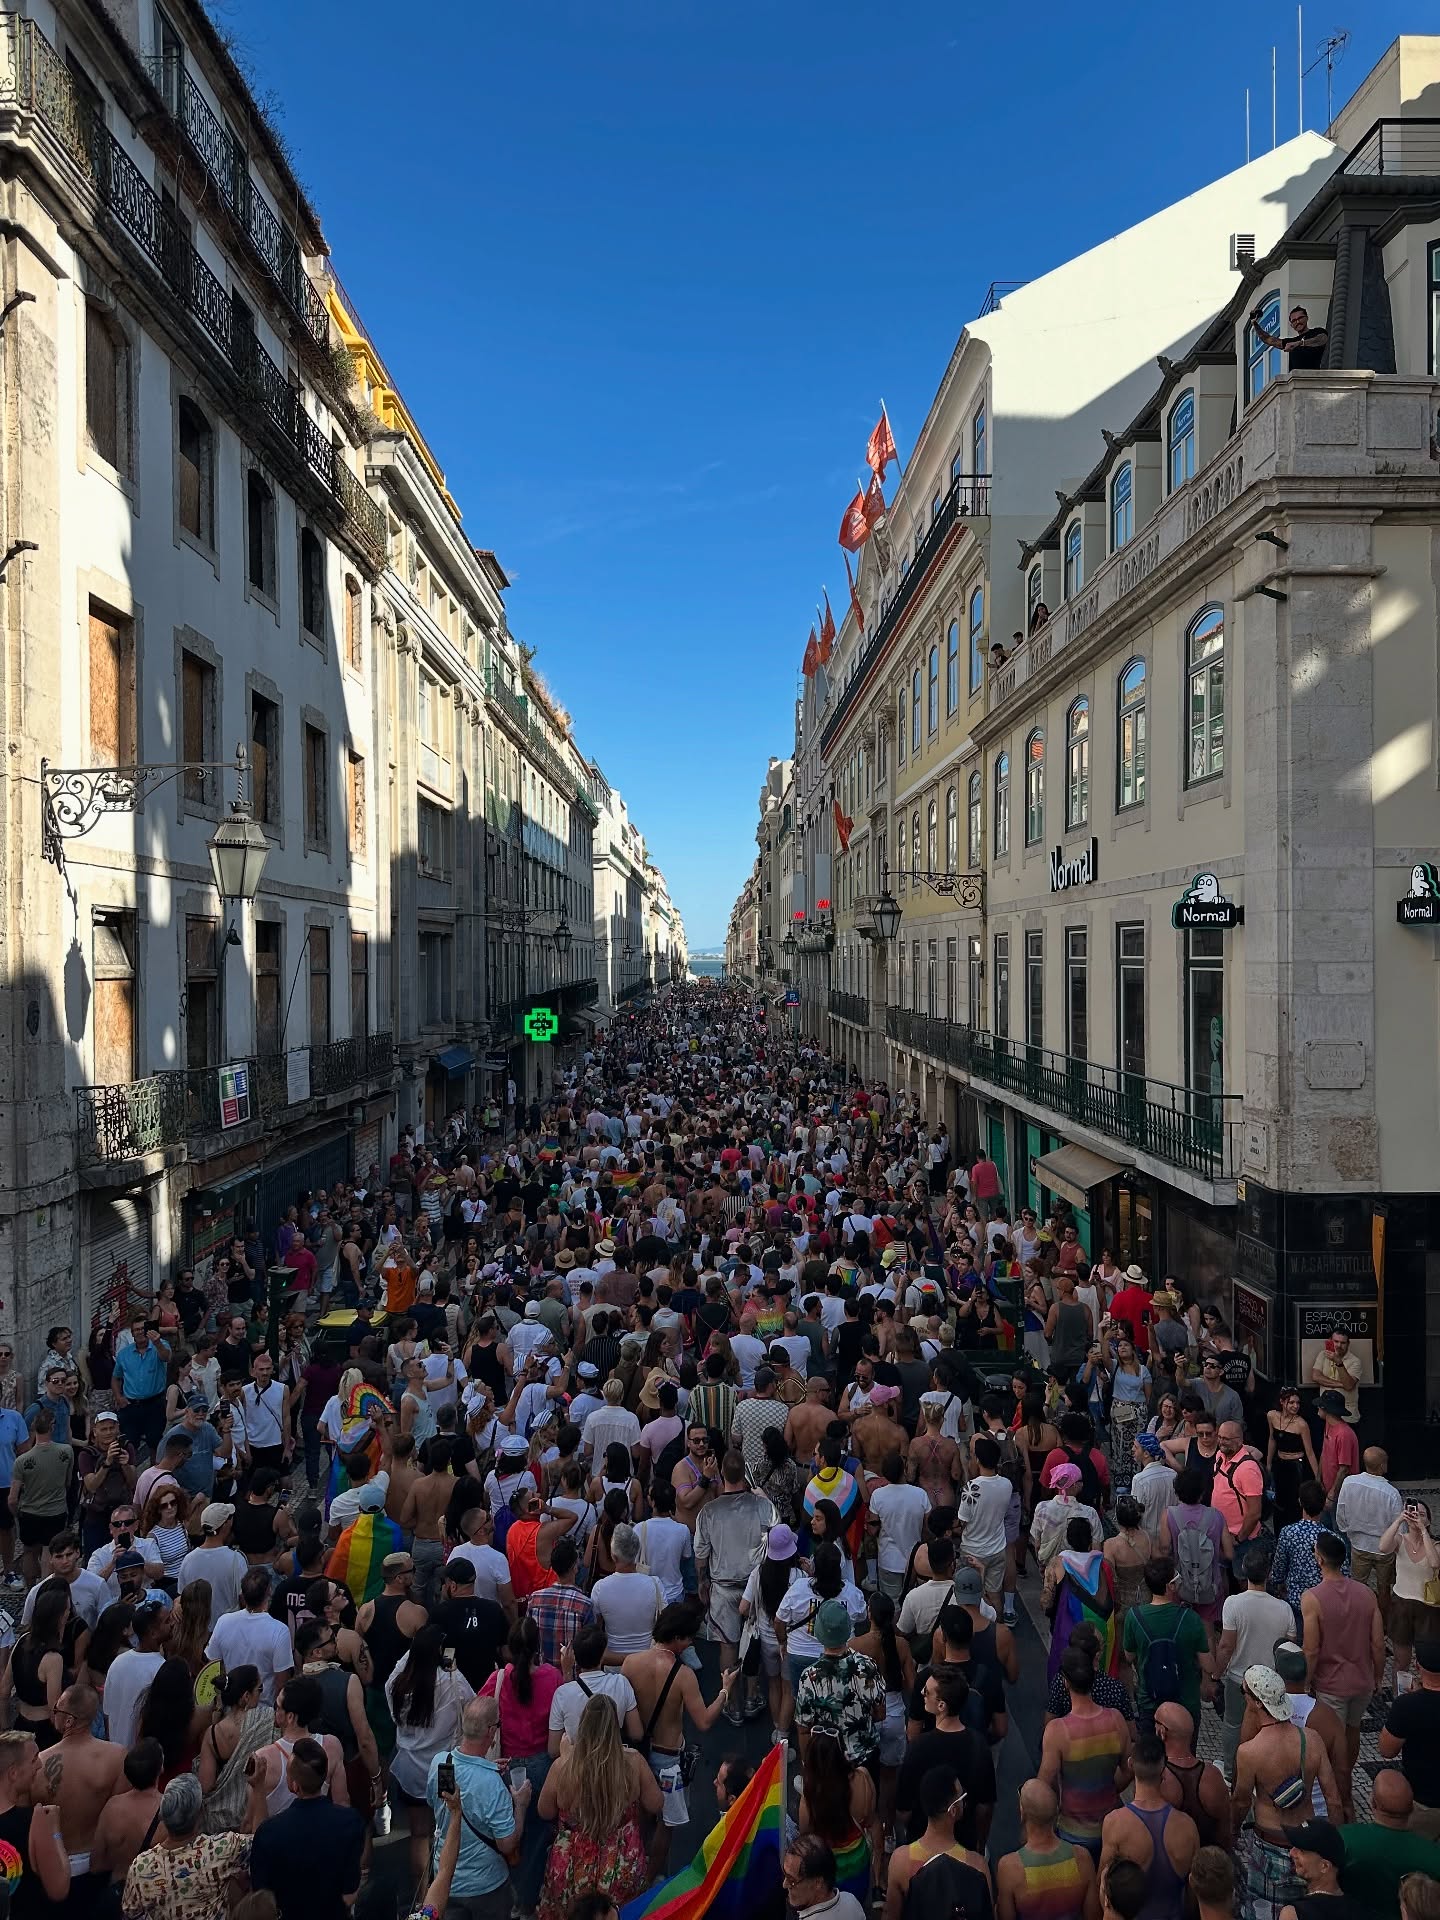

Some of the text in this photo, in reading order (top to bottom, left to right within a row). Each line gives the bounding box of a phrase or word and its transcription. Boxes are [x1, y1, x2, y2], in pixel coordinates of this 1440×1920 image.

[1050, 837, 1097, 892] Normal
[1183, 906, 1230, 923] Normal
[1404, 902, 1433, 919] Normal
[1305, 1310, 1352, 1323] ESPAÇO
